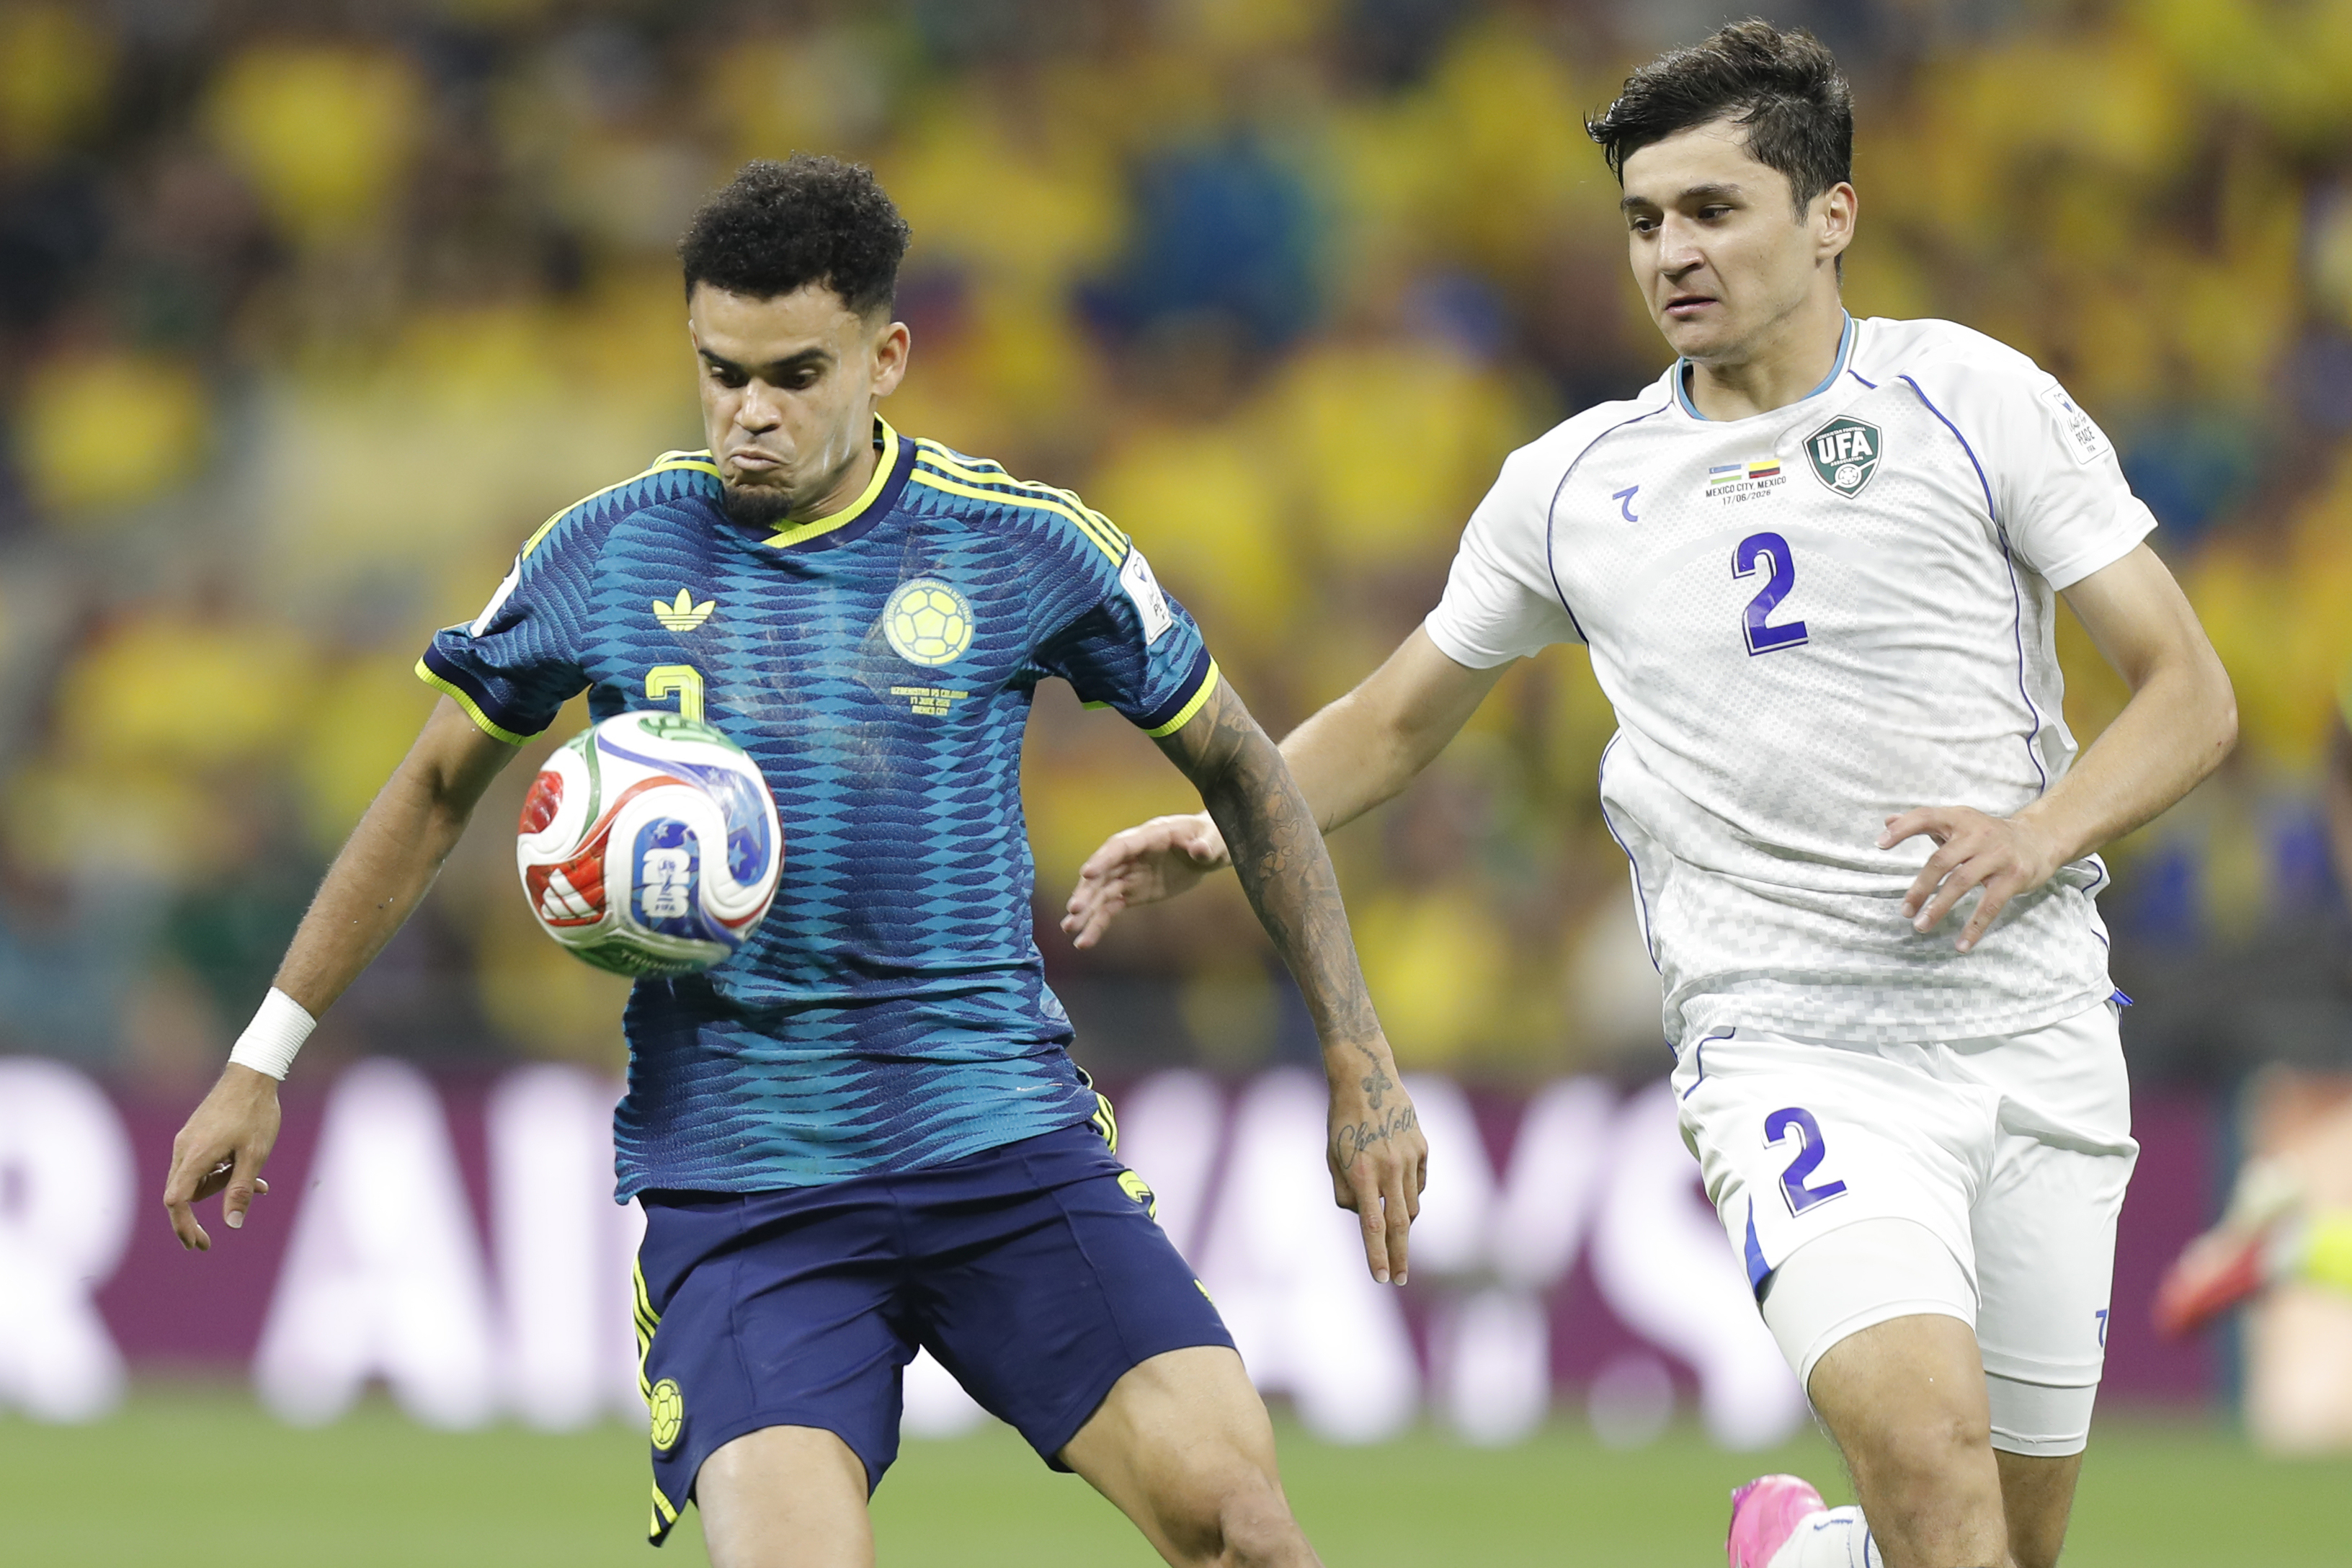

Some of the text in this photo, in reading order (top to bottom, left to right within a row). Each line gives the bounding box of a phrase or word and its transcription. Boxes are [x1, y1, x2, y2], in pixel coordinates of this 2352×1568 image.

[1817, 431, 1874, 464] UFA
[2075, 427, 2095, 446] PEACE
[1706, 484, 1734, 497] MEXICO
[1758, 476, 1786, 489] MEXICO
[1722, 489, 1771, 506] 17/06/2026
[1731, 532, 1809, 656] 2
[1760, 1107, 1848, 1219] 2
